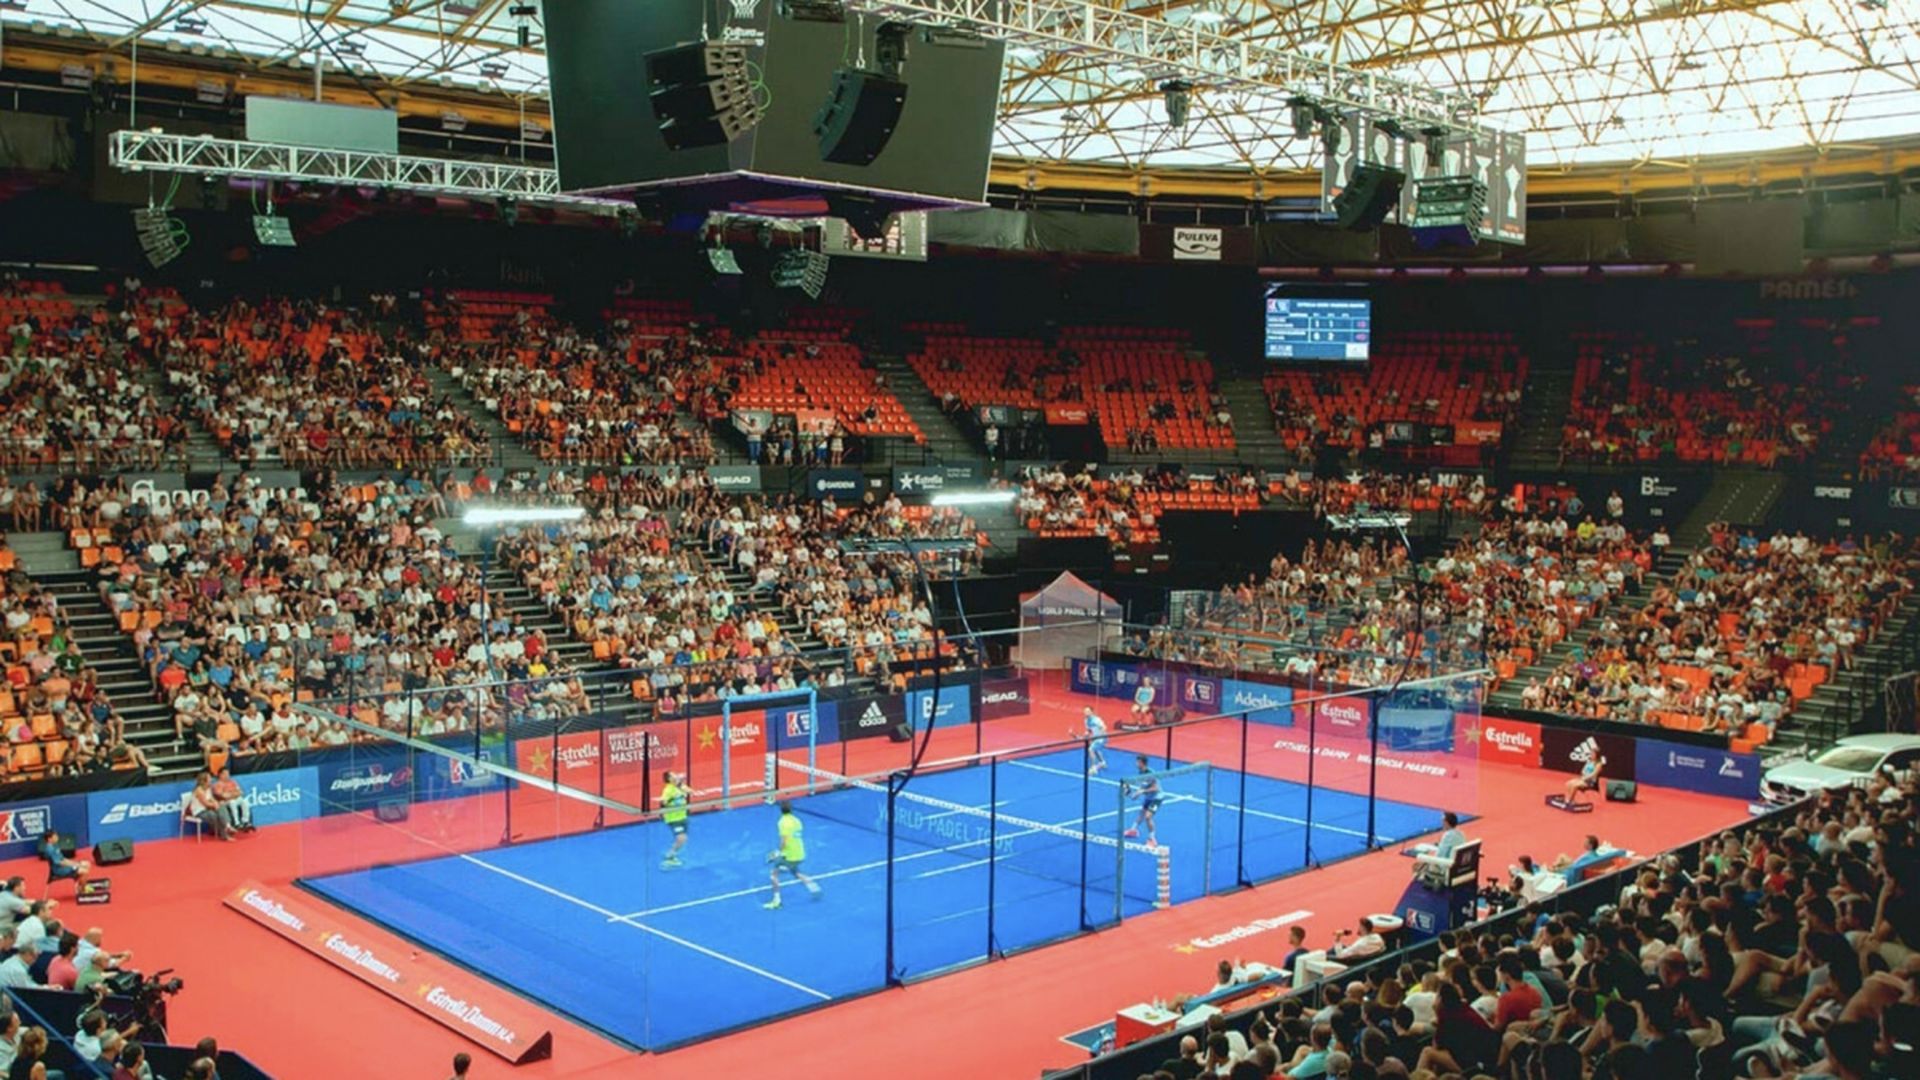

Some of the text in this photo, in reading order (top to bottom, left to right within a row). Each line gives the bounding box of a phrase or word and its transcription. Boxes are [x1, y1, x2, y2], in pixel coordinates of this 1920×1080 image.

[1177, 231, 1218, 242] PULEVA
[1814, 486, 1852, 499] SPORT
[1087, 608, 1106, 618] TOR
[981, 691, 1018, 704] HEAD
[1320, 703, 1362, 721] Estrella
[858, 715, 888, 728] adidas
[609, 735, 660, 753] VALENIA
[1485, 727, 1533, 748] Estrella
[1404, 763, 1447, 777] MASTER
[248, 785, 301, 807] deslas
[128, 799, 183, 819] Babol
[927, 815, 971, 842] PADEL
[325, 932, 362, 964] Estrella
[426, 986, 468, 1021] Estrella
